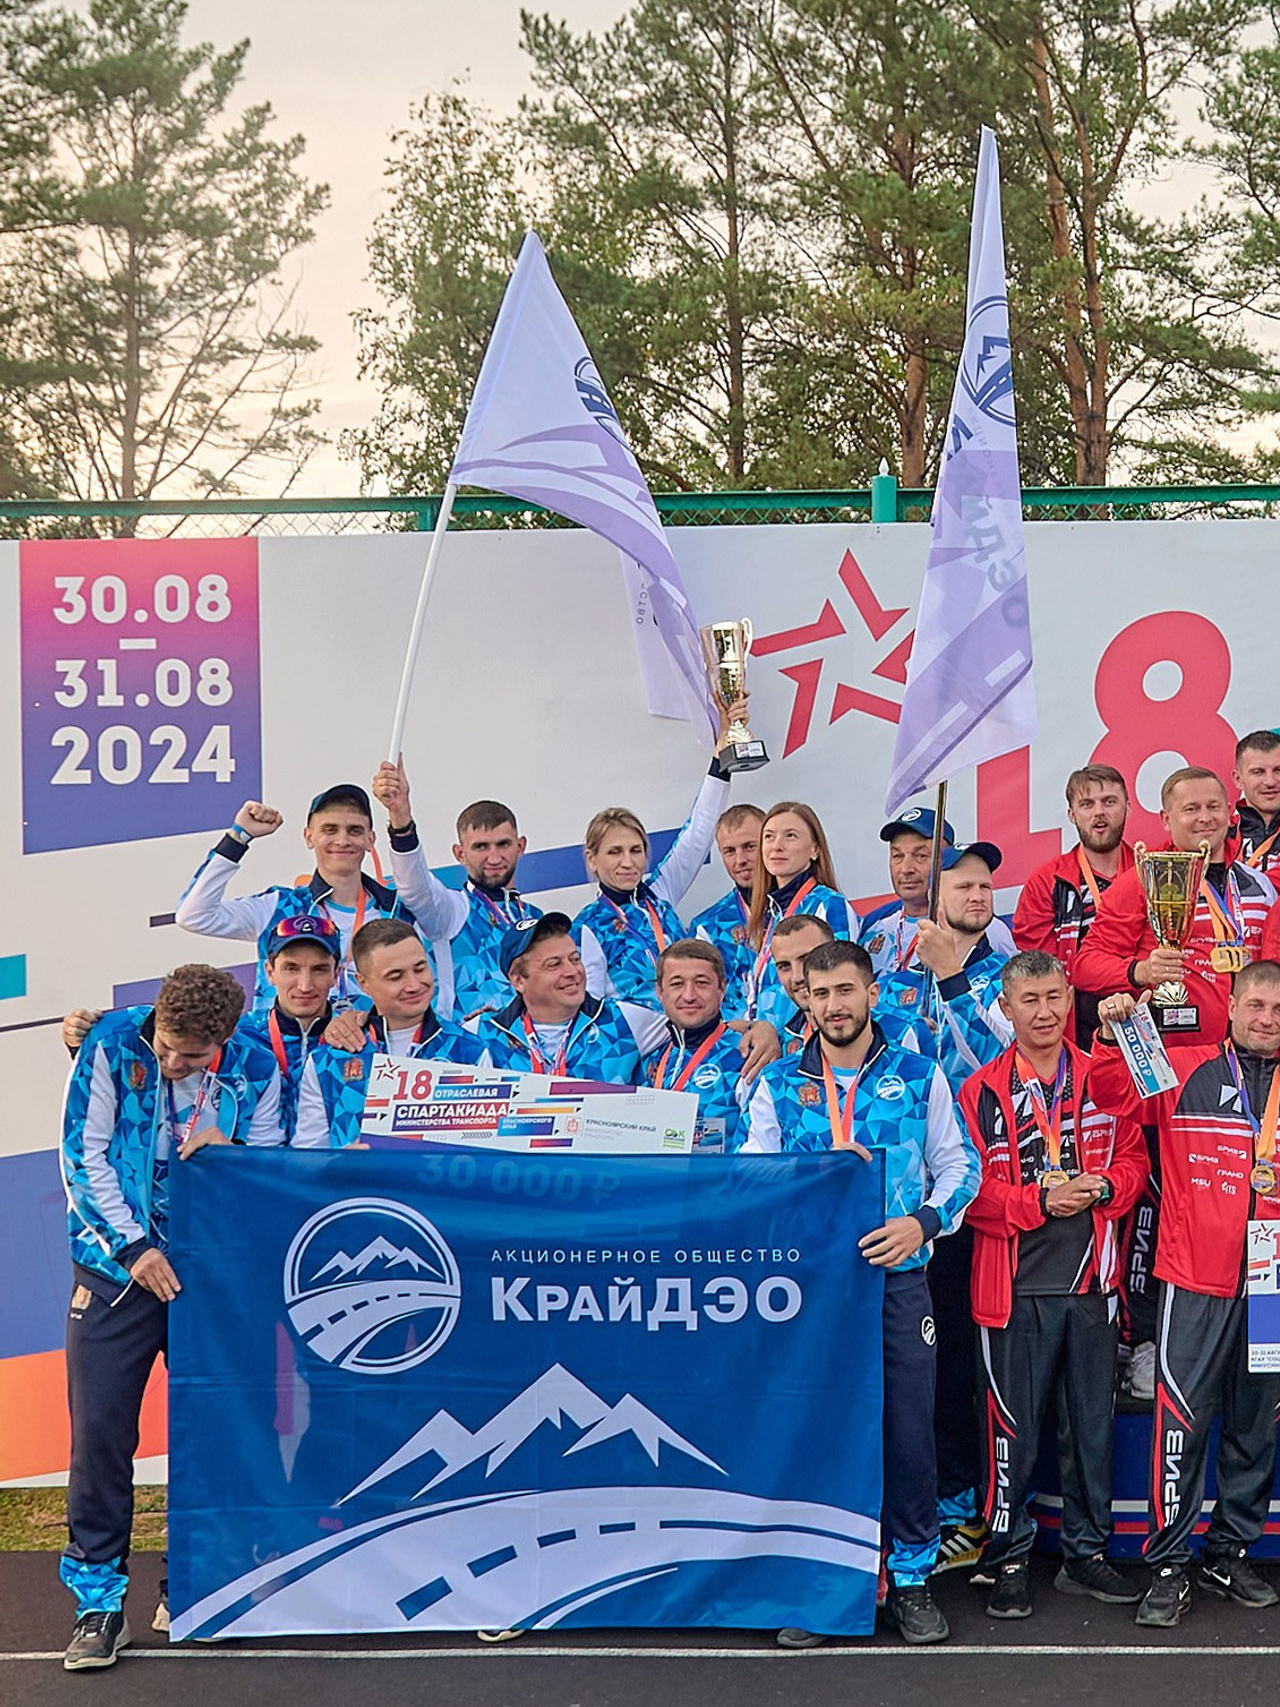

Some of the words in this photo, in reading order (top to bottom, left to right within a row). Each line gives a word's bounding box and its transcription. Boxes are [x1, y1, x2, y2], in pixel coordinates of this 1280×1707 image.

[53, 574, 233, 625] 30.08
[53, 657, 234, 708] 31.08
[50, 724, 235, 786] 2024
[393, 1070, 433, 1100] 18
[435, 1088, 498, 1099] ОТРАСЛЕВАЯ
[397, 1103, 507, 1118] СПАРТАКИАДА
[452, 1116, 497, 1125] ТРАНСПОРТА
[491, 1249, 662, 1264] АКЦИОНЕРНОЕ
[674, 1248, 801, 1264] ОБЩЕСТВО
[1130, 1206, 1153, 1294] БРИЗ
[992, 1436, 1010, 1533] БРИЗ
